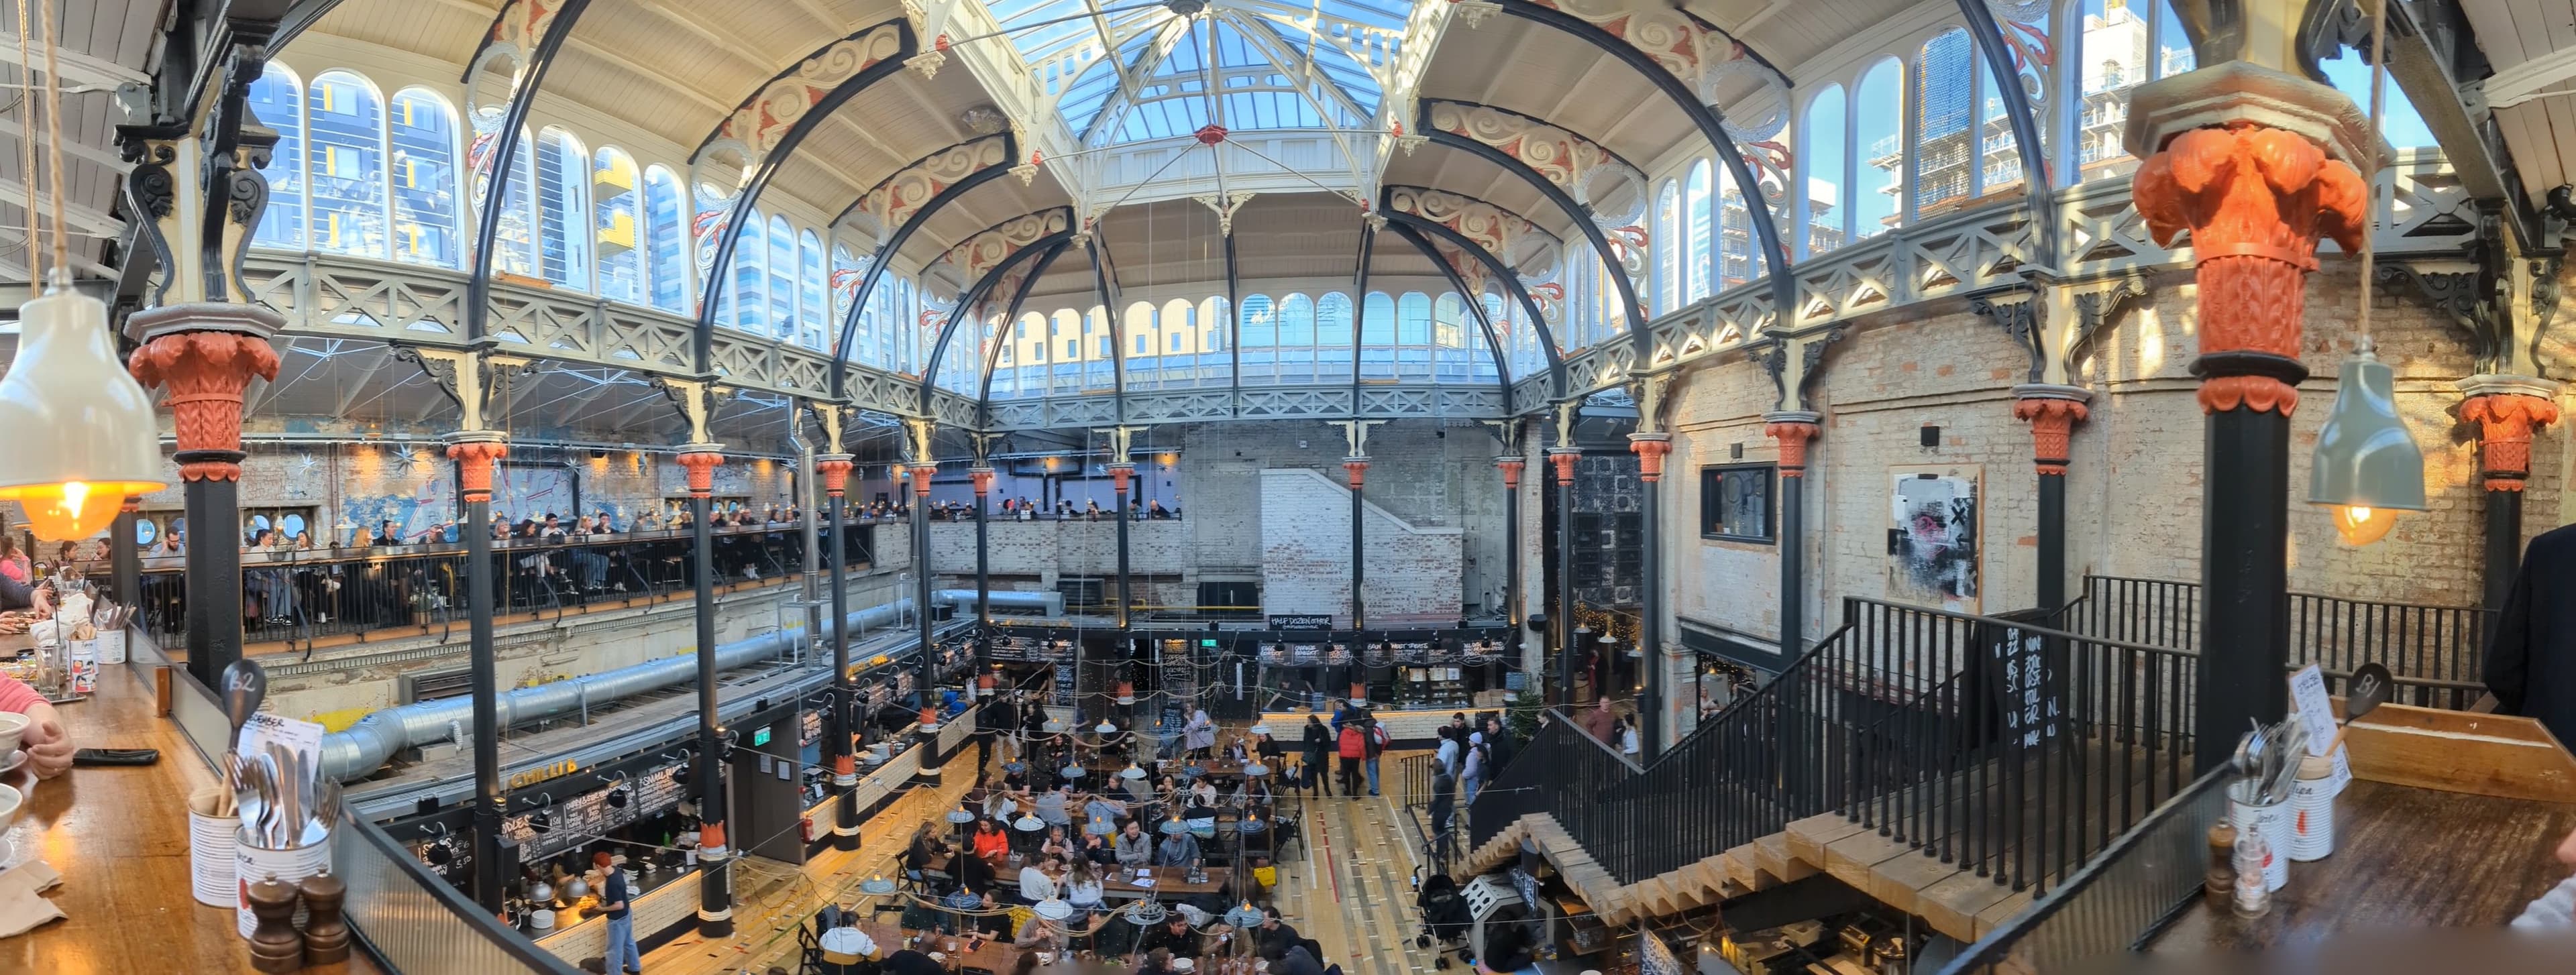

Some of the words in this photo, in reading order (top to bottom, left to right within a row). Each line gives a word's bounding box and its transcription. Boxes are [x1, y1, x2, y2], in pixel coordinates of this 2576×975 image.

[1271, 617, 1289, 626] HALF
[1289, 617, 1310, 625] DOZEN
[1310, 617, 1332, 625] OTHER
[229, 670, 256, 692] B2
[2355, 673, 2381, 698] B1
[249, 713, 284, 727] CEMBER
[511, 761, 564, 788] CHILLI
[566, 758, 578, 774] B
